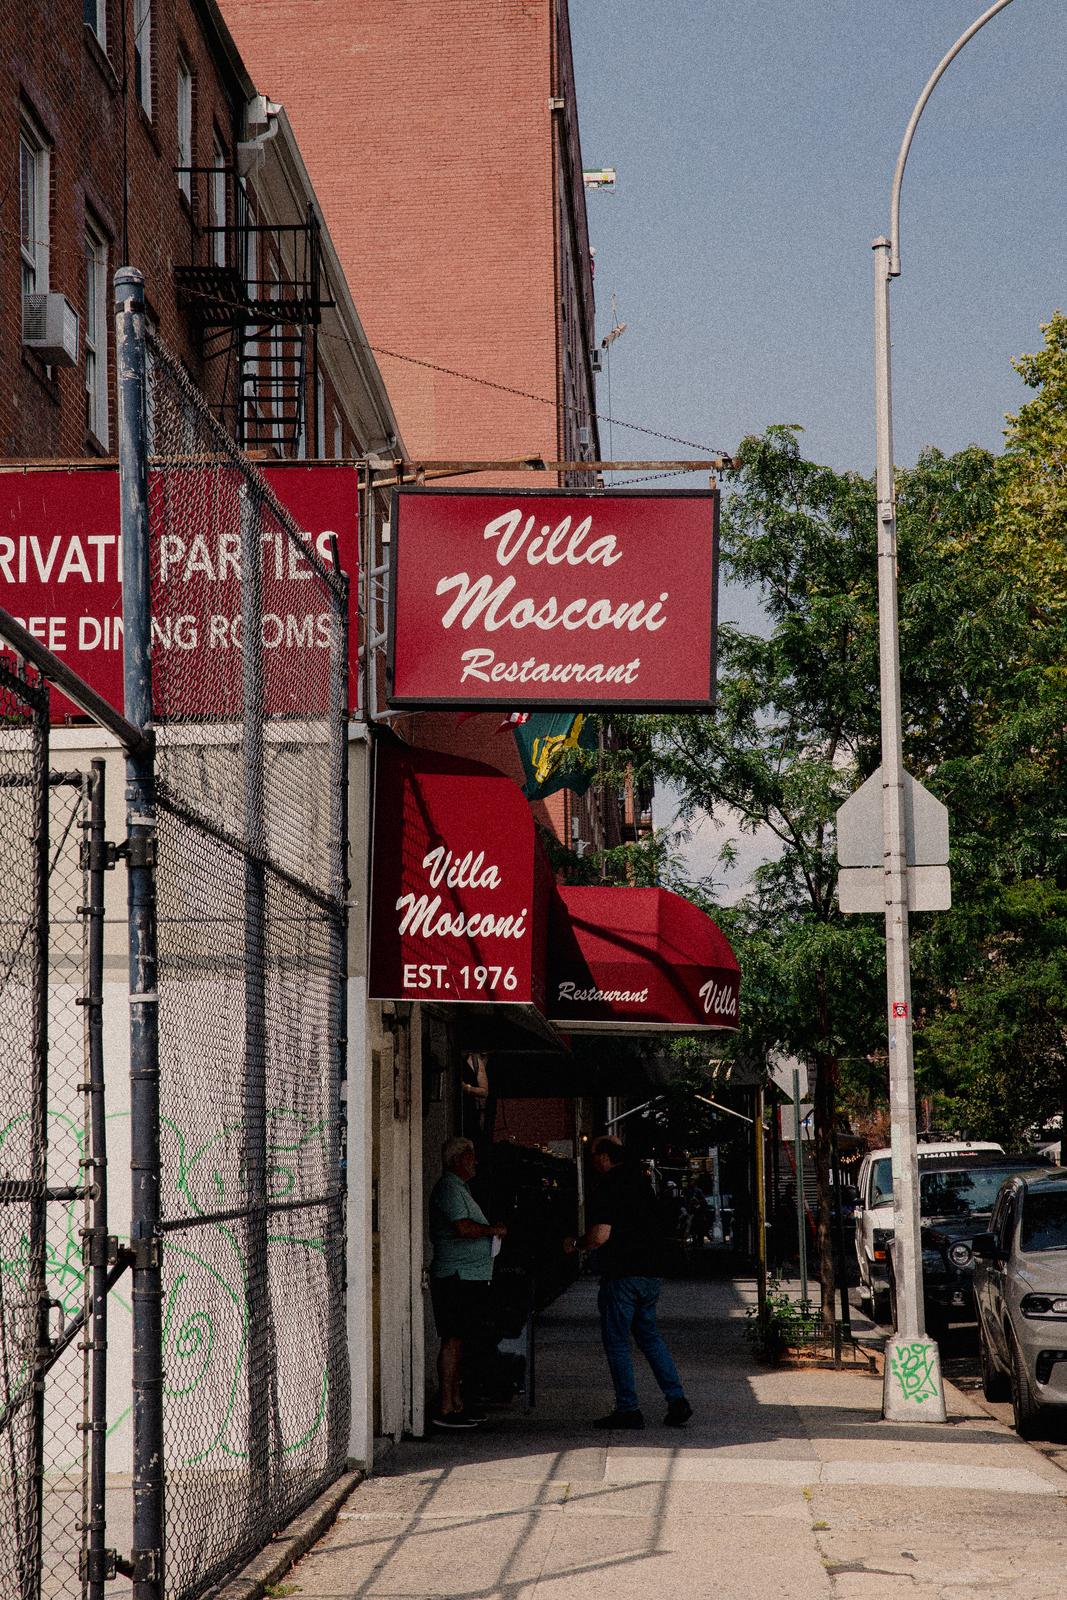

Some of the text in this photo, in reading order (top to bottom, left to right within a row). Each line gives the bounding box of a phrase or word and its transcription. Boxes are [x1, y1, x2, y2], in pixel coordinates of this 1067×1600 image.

[0, 535, 124, 583] RIVAT
[483, 508, 622, 567] Villa
[435, 571, 669, 632] Mosconi
[460, 647, 641, 685] Restaurant
[422, 845, 502, 890] Villa
[395, 892, 527, 939] Mosconi
[402, 964, 518, 990] EST. 1976
[557, 981, 648, 1004] Restaurant
[698, 979, 737, 1016] Villa
